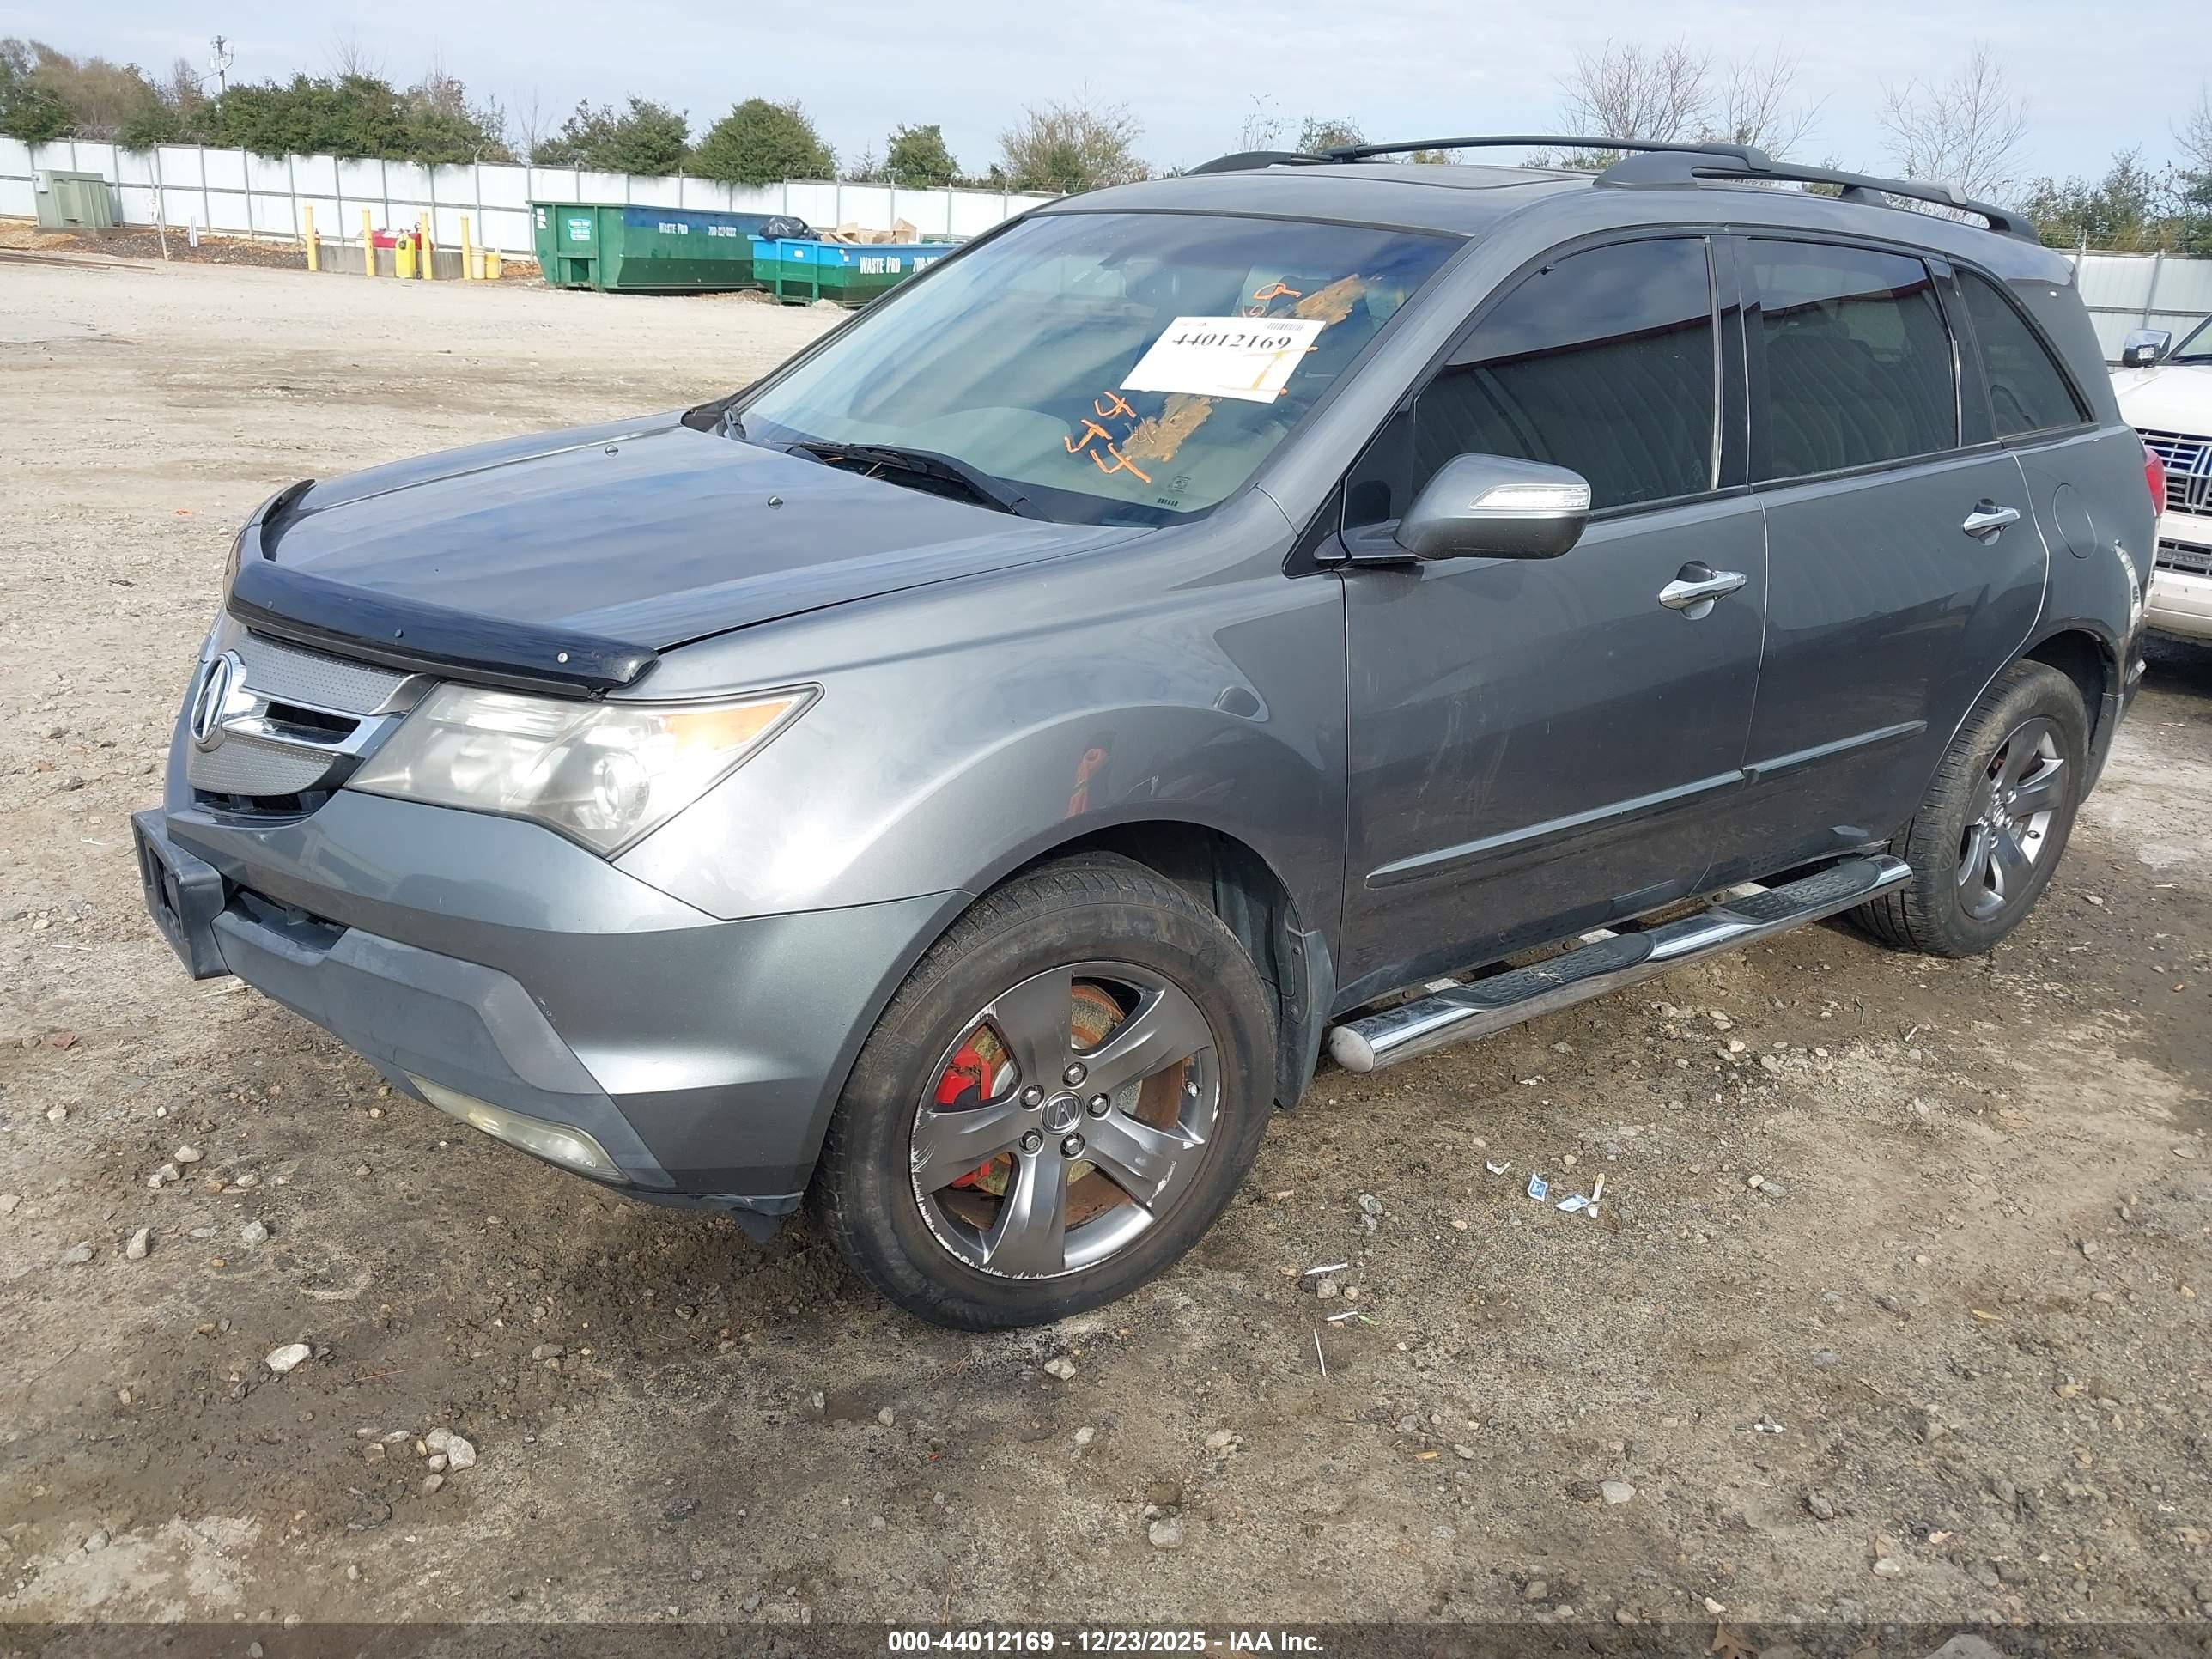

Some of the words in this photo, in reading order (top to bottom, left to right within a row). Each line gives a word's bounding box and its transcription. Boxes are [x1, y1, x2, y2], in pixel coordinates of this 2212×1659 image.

[678, 223, 688, 234] PRO
[860, 256, 884, 274] WASTE
[886, 256, 901, 274] PRO
[1171, 332, 1292, 350] 44012169
